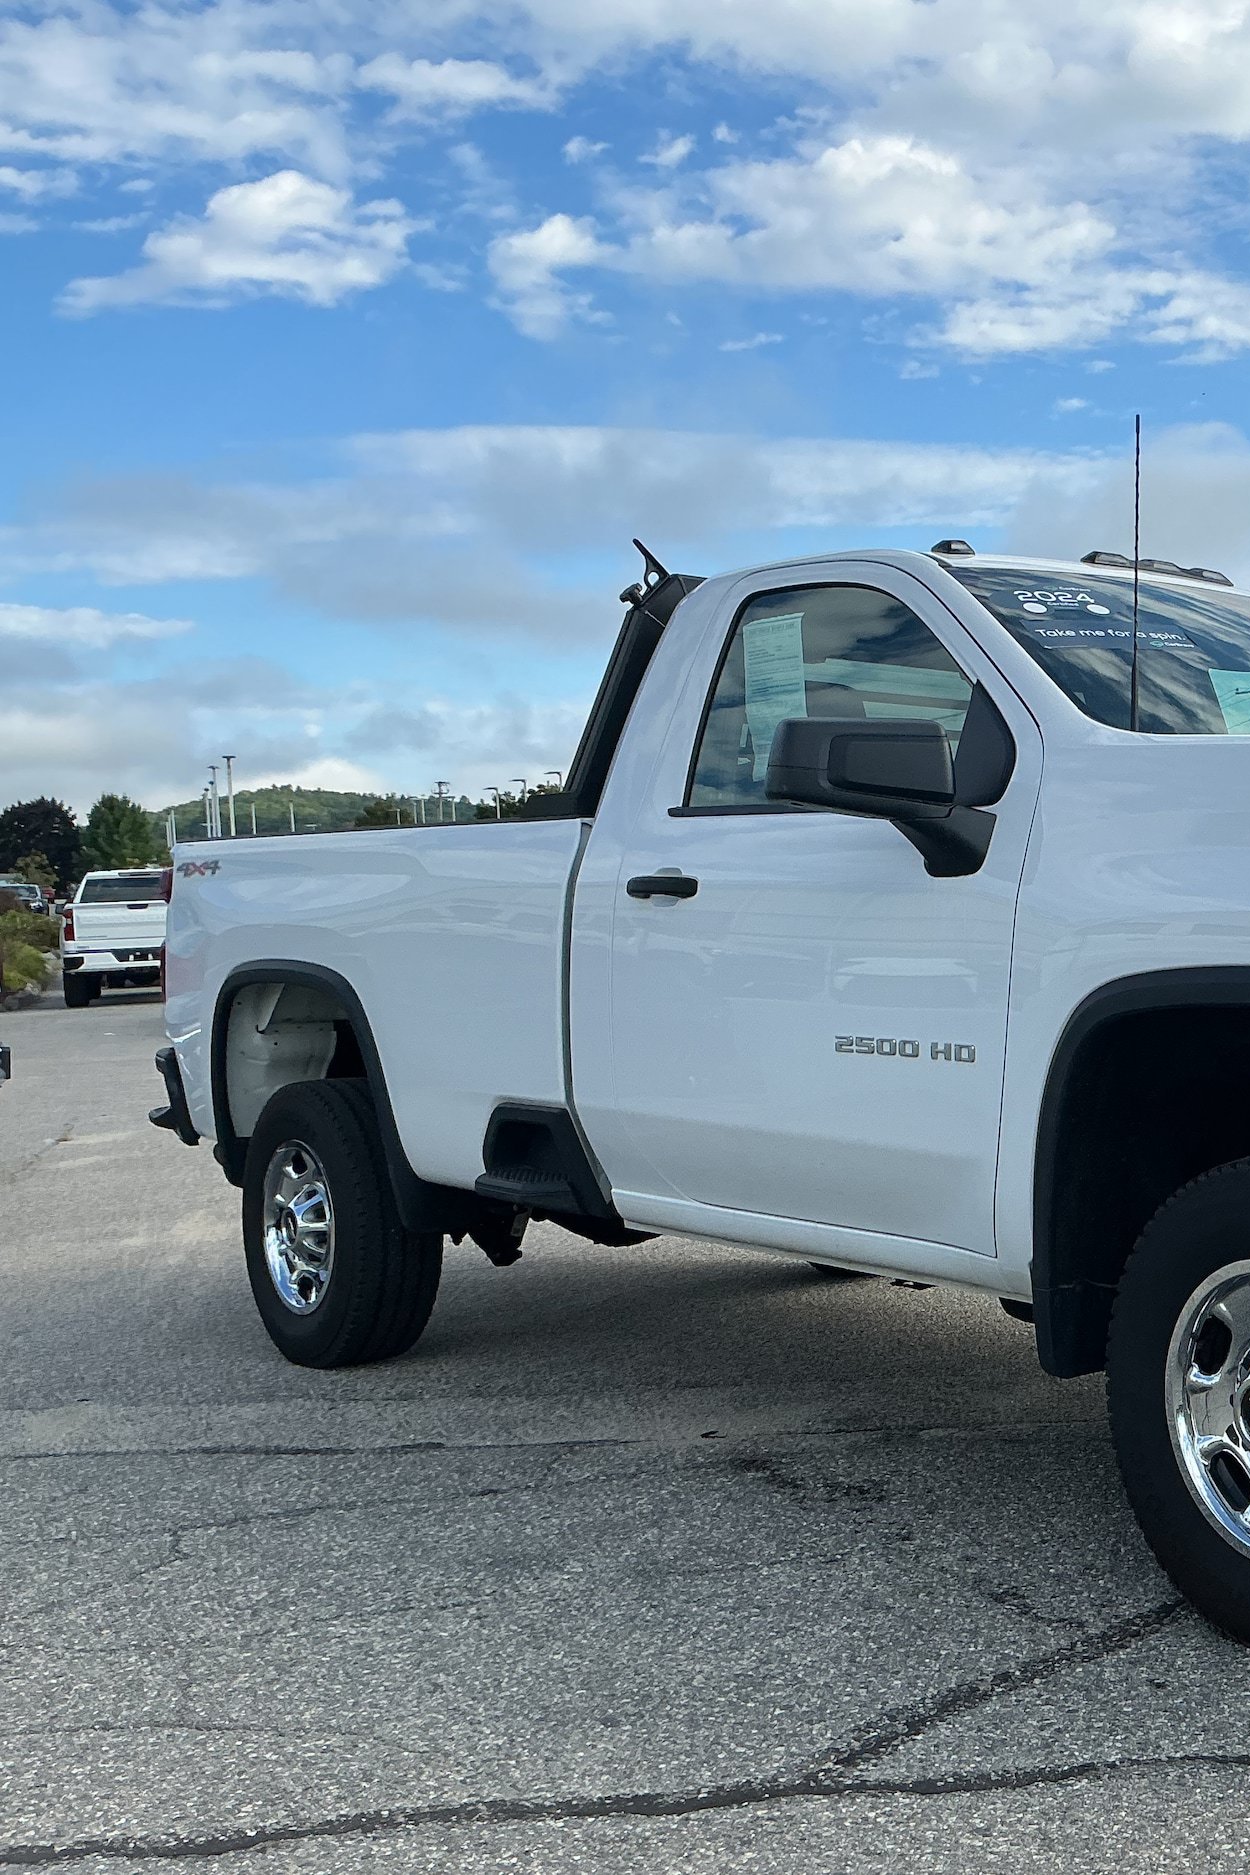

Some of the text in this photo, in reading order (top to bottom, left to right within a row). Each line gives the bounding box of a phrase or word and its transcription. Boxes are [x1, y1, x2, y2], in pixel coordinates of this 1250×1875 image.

[1013, 590, 1095, 604] 2024
[1034, 628, 1077, 638] Take
[1079, 629, 1106, 638] me
[1107, 629, 1131, 638] for
[1148, 631, 1186, 641] spin.
[834, 1035, 976, 1063] 2500 HD
